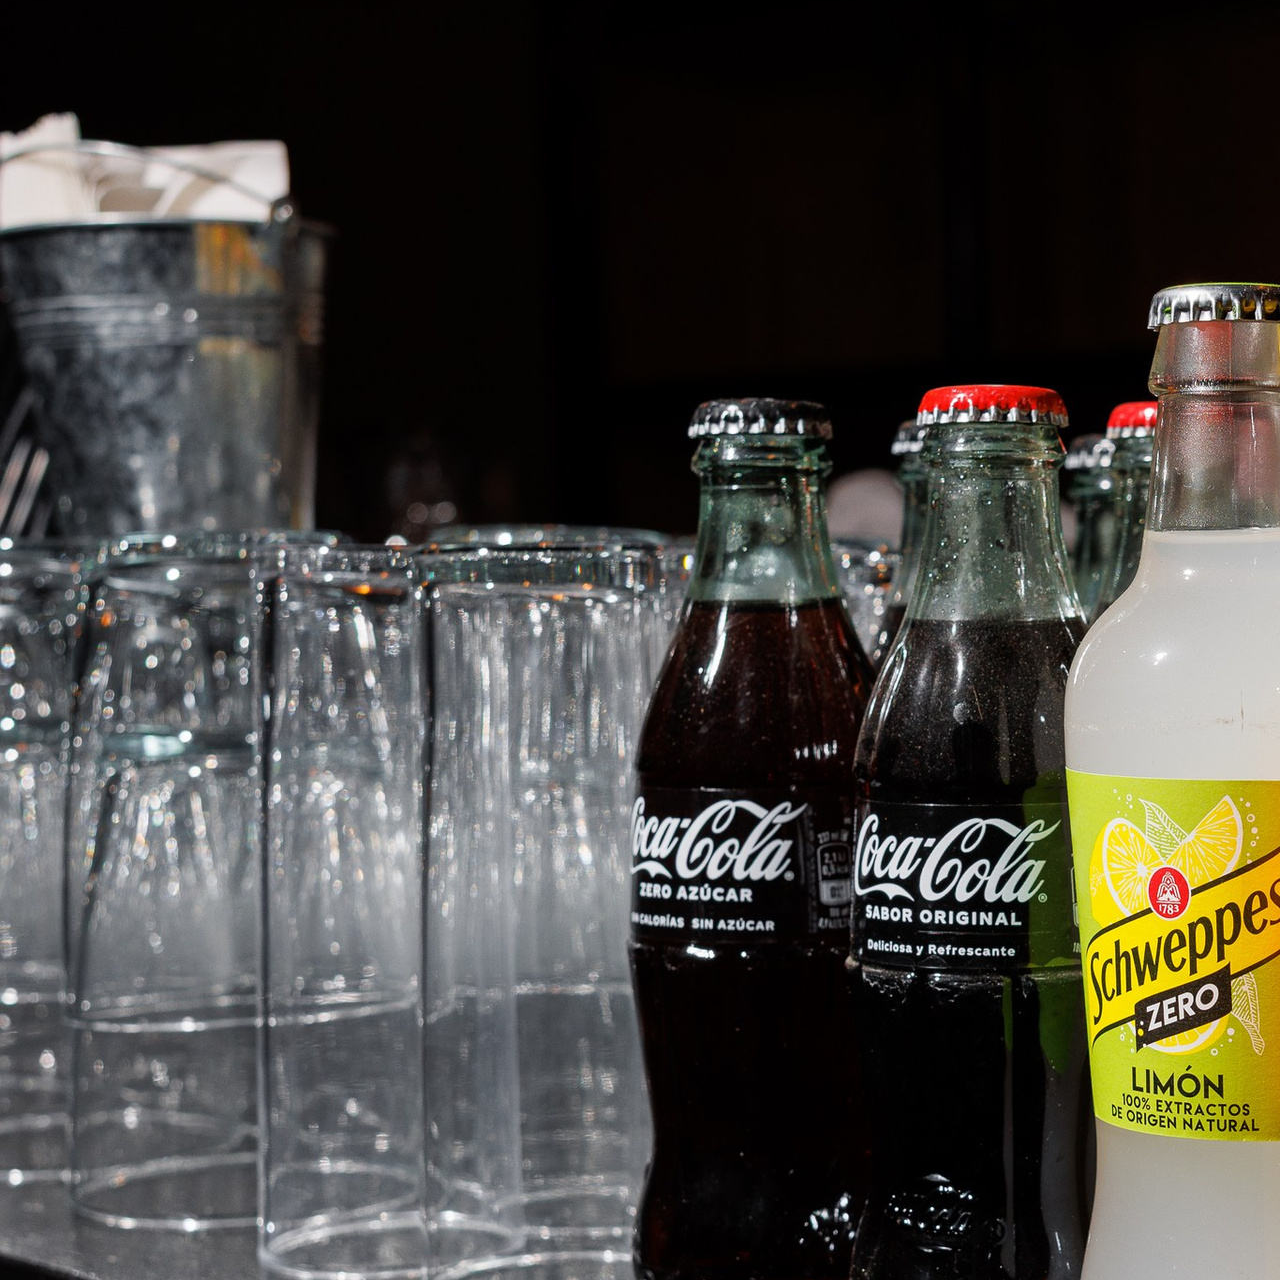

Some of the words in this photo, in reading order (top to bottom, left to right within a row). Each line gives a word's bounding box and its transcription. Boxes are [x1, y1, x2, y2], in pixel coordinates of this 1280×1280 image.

[854, 813, 1061, 903] Coca-Cola
[639, 882, 672, 899] ZERO
[676, 883, 753, 903] AZÚCAR
[865, 904, 913, 923] SABOR
[919, 909, 1022, 926] ORIGINAL
[1159, 903, 1180, 916] 1783
[639, 913, 685, 929] CALORÍAS
[691, 919, 714, 931] SIN
[717, 917, 775, 932] AZÚCAR
[867, 939, 913, 954] Deliciosa
[915, 945, 924, 956] y
[927, 944, 1016, 957] Refrescante
[1146, 983, 1220, 1032] ZERO
[1132, 1064, 1224, 1099] LIMÓN
[1122, 1093, 1151, 1111] 100%
[1156, 1099, 1251, 1117] EXTRACTOS
[1111, 1104, 1123, 1120] DE
[1126, 1109, 1177, 1129] ORIGEN
[1182, 1118, 1260, 1132] NATURAL
